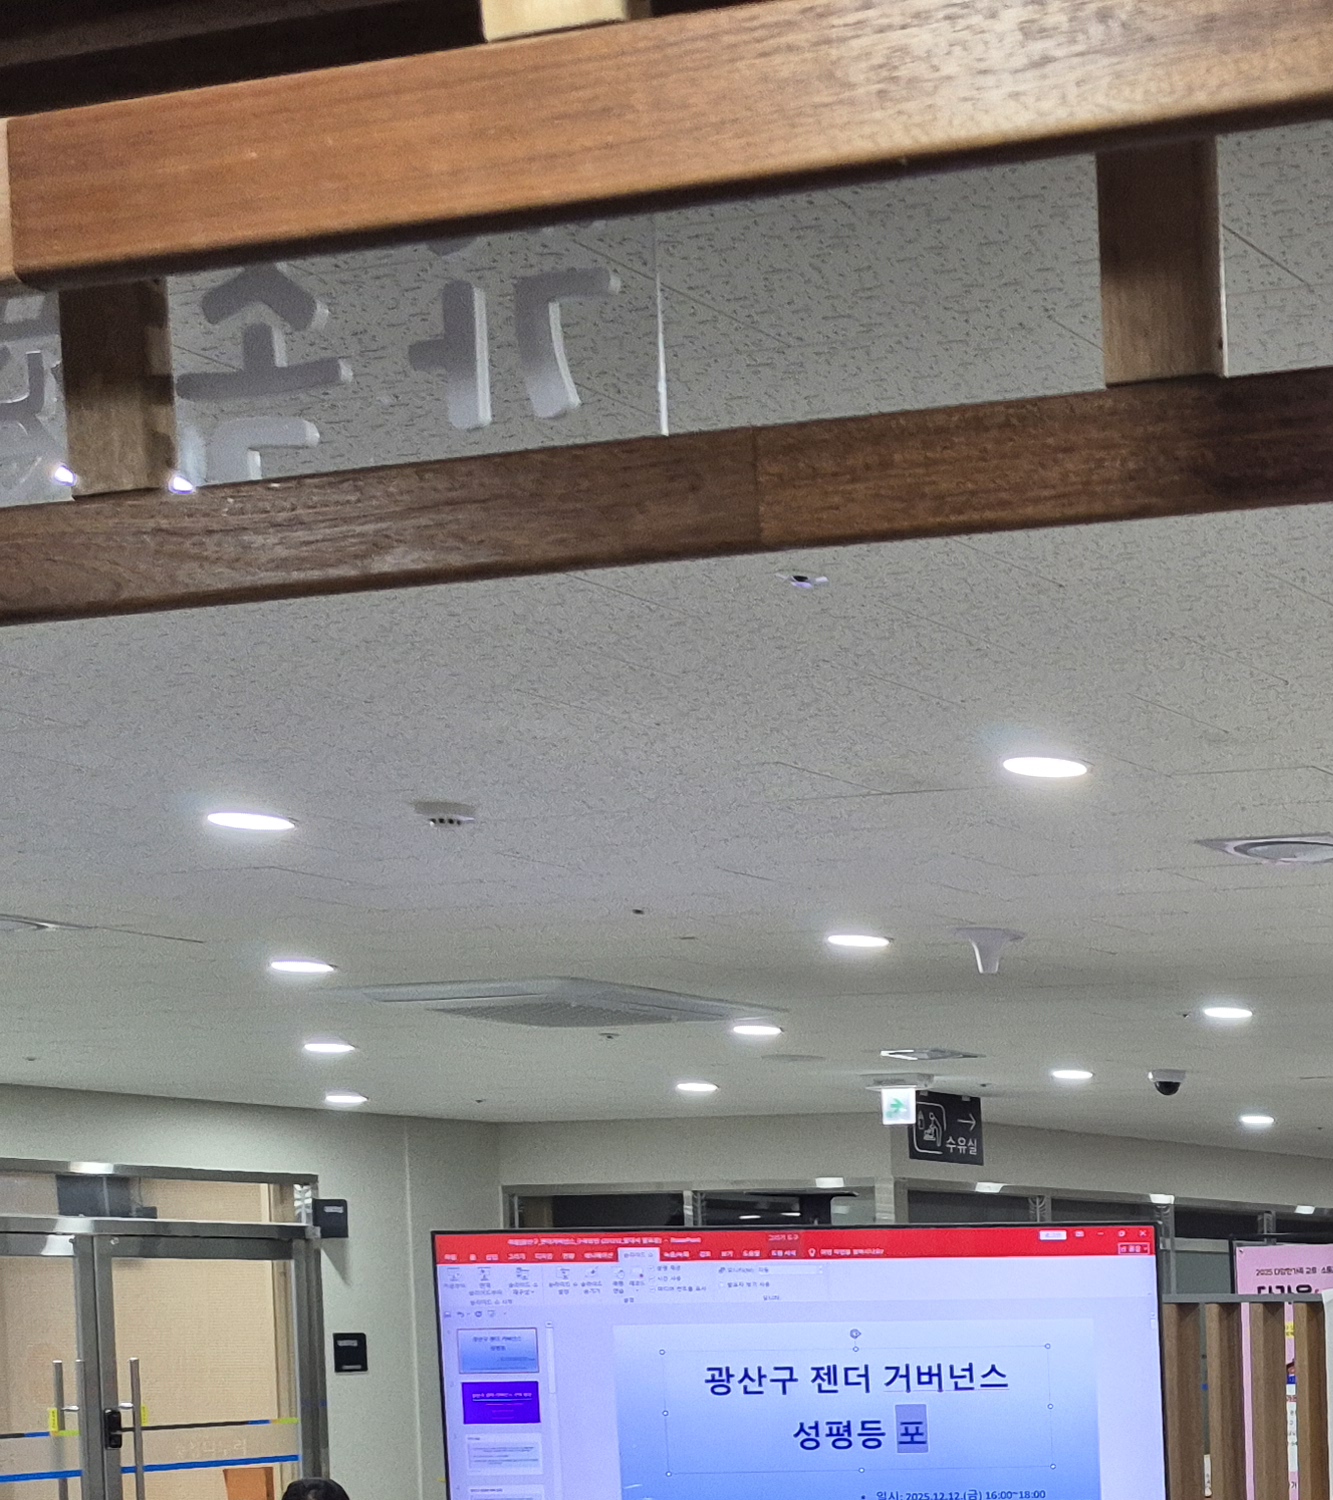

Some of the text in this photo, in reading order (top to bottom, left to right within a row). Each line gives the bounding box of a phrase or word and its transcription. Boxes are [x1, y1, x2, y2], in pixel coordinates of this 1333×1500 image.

[946, 1136, 978, 1155] 수유실
[705, 1361, 1009, 1396] 광산구 젠더 거버넌스
[793, 1420, 927, 1450] 성평등 포
